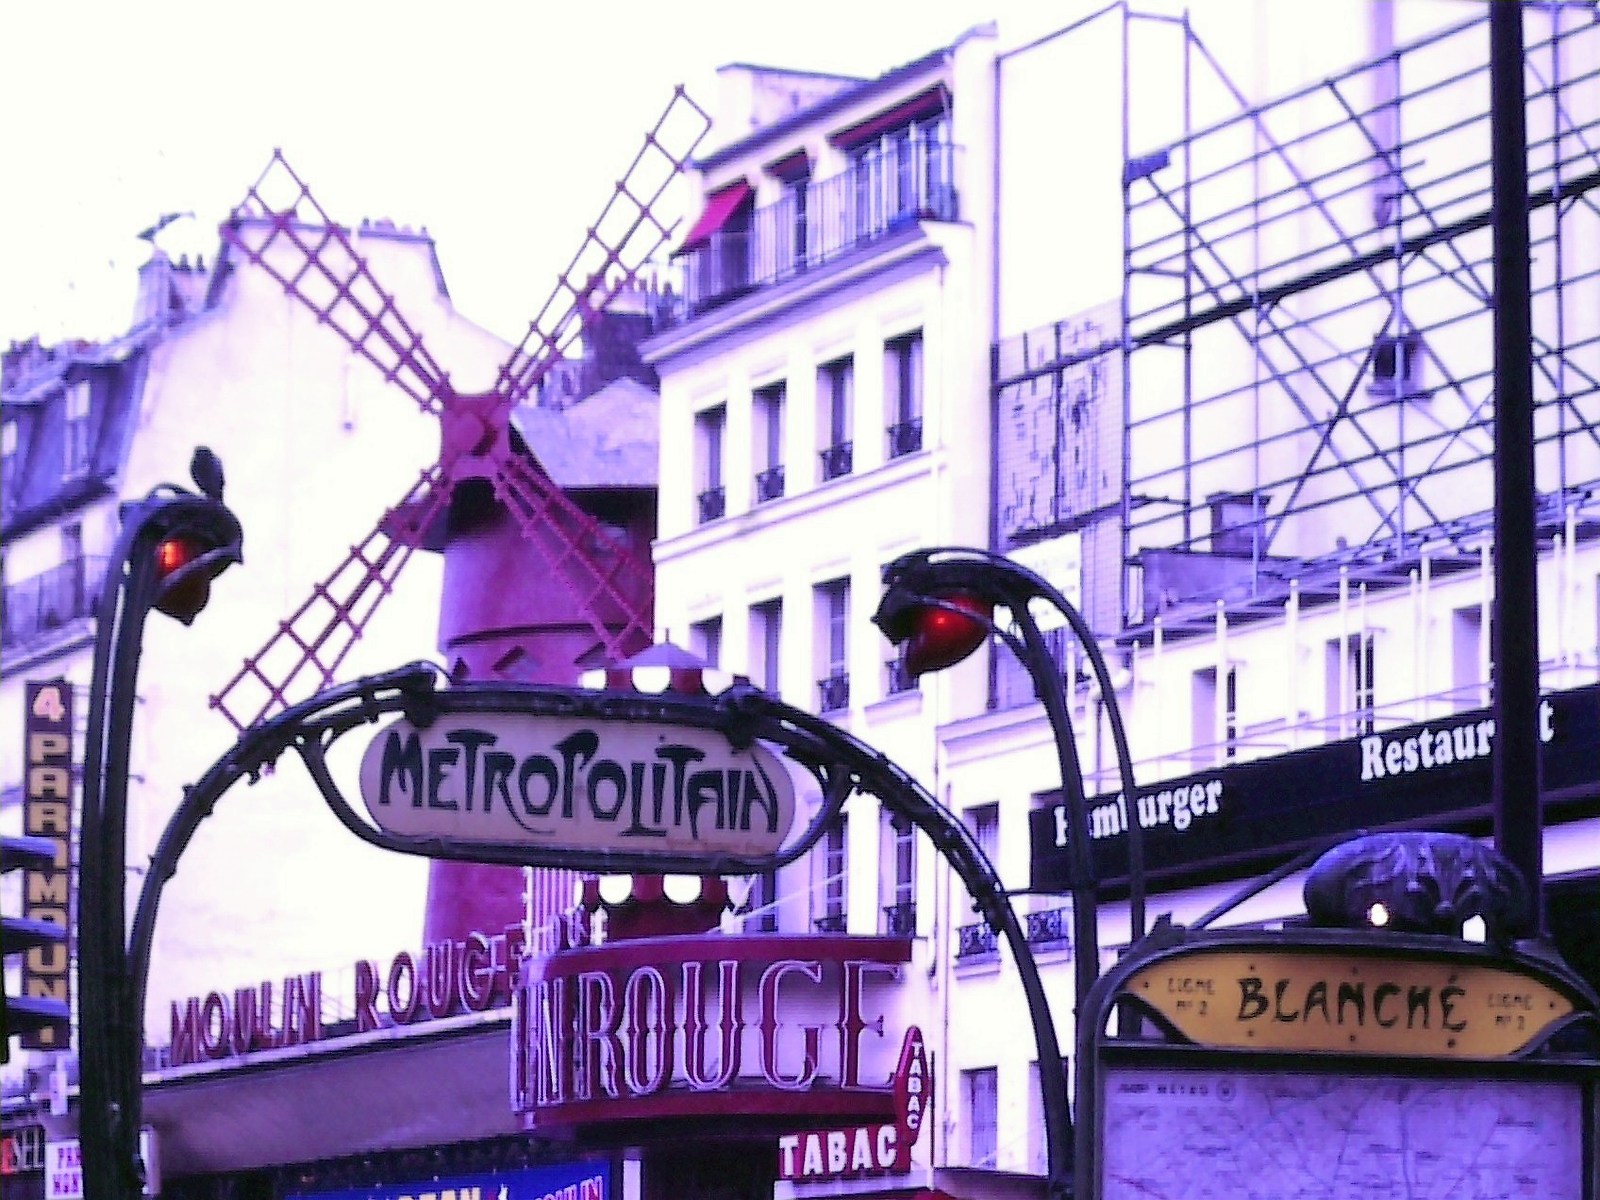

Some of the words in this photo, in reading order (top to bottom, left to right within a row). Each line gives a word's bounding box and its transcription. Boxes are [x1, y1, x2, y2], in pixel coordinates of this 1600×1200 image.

[32, 686, 66, 723] 4
[1361, 700, 1554, 782] Restaurt
[378, 728, 778, 840] METROPOLITAIN
[1054, 779, 1223, 847] Hmurger
[170, 971, 322, 1067] MOULIN
[355, 922, 523, 1033] ROUGE
[572, 960, 900, 1099] ROUGE
[1236, 975, 1467, 1033] BLANCHE
[906, 1041, 922, 1130] TABAC
[779, 1124, 897, 1176] TABAC
